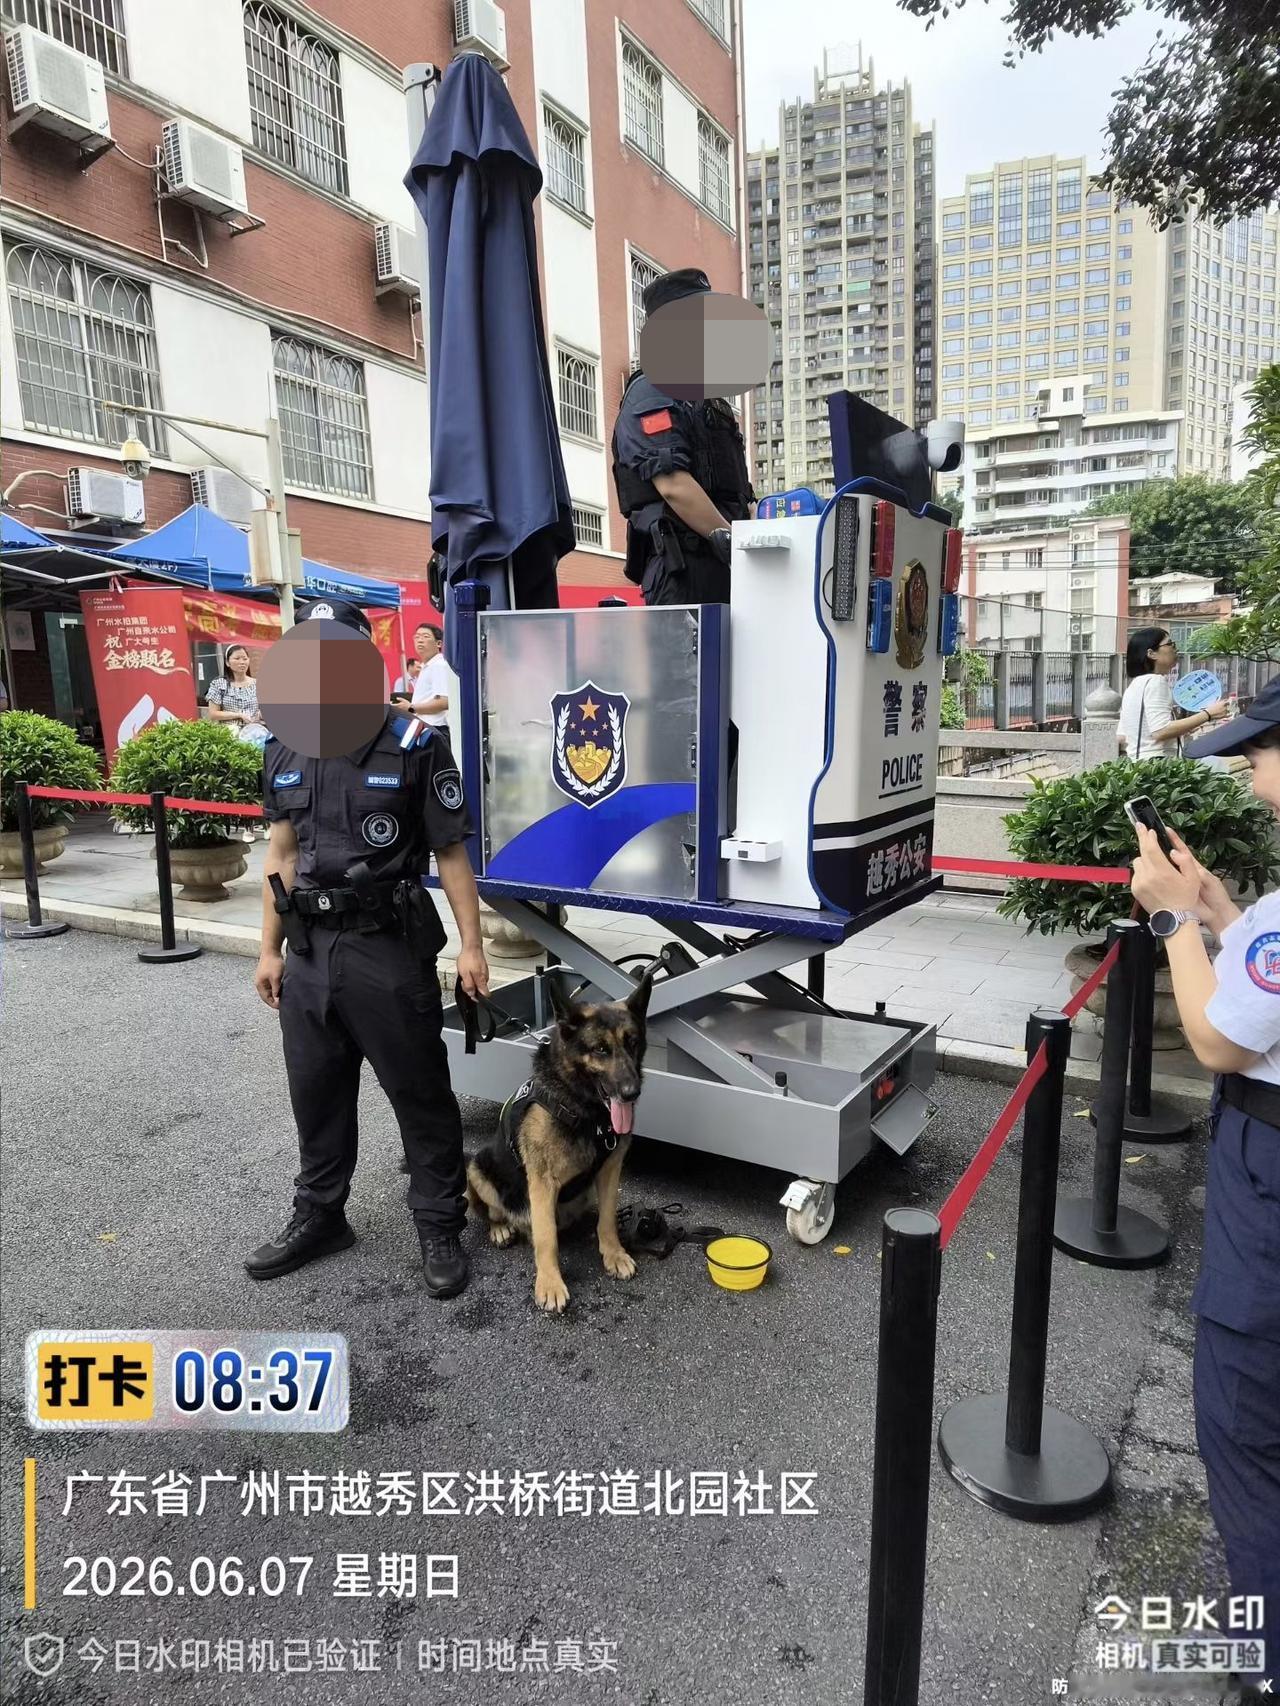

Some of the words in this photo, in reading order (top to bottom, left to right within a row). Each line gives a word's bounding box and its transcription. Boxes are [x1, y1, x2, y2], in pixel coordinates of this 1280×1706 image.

[103, 634, 123, 649] 祝
[103, 647, 177, 671] 金榜题名
[882, 679, 928, 738] 警察
[881, 753, 923, 790] POLICE
[866, 832, 926, 897] 越秀公安
